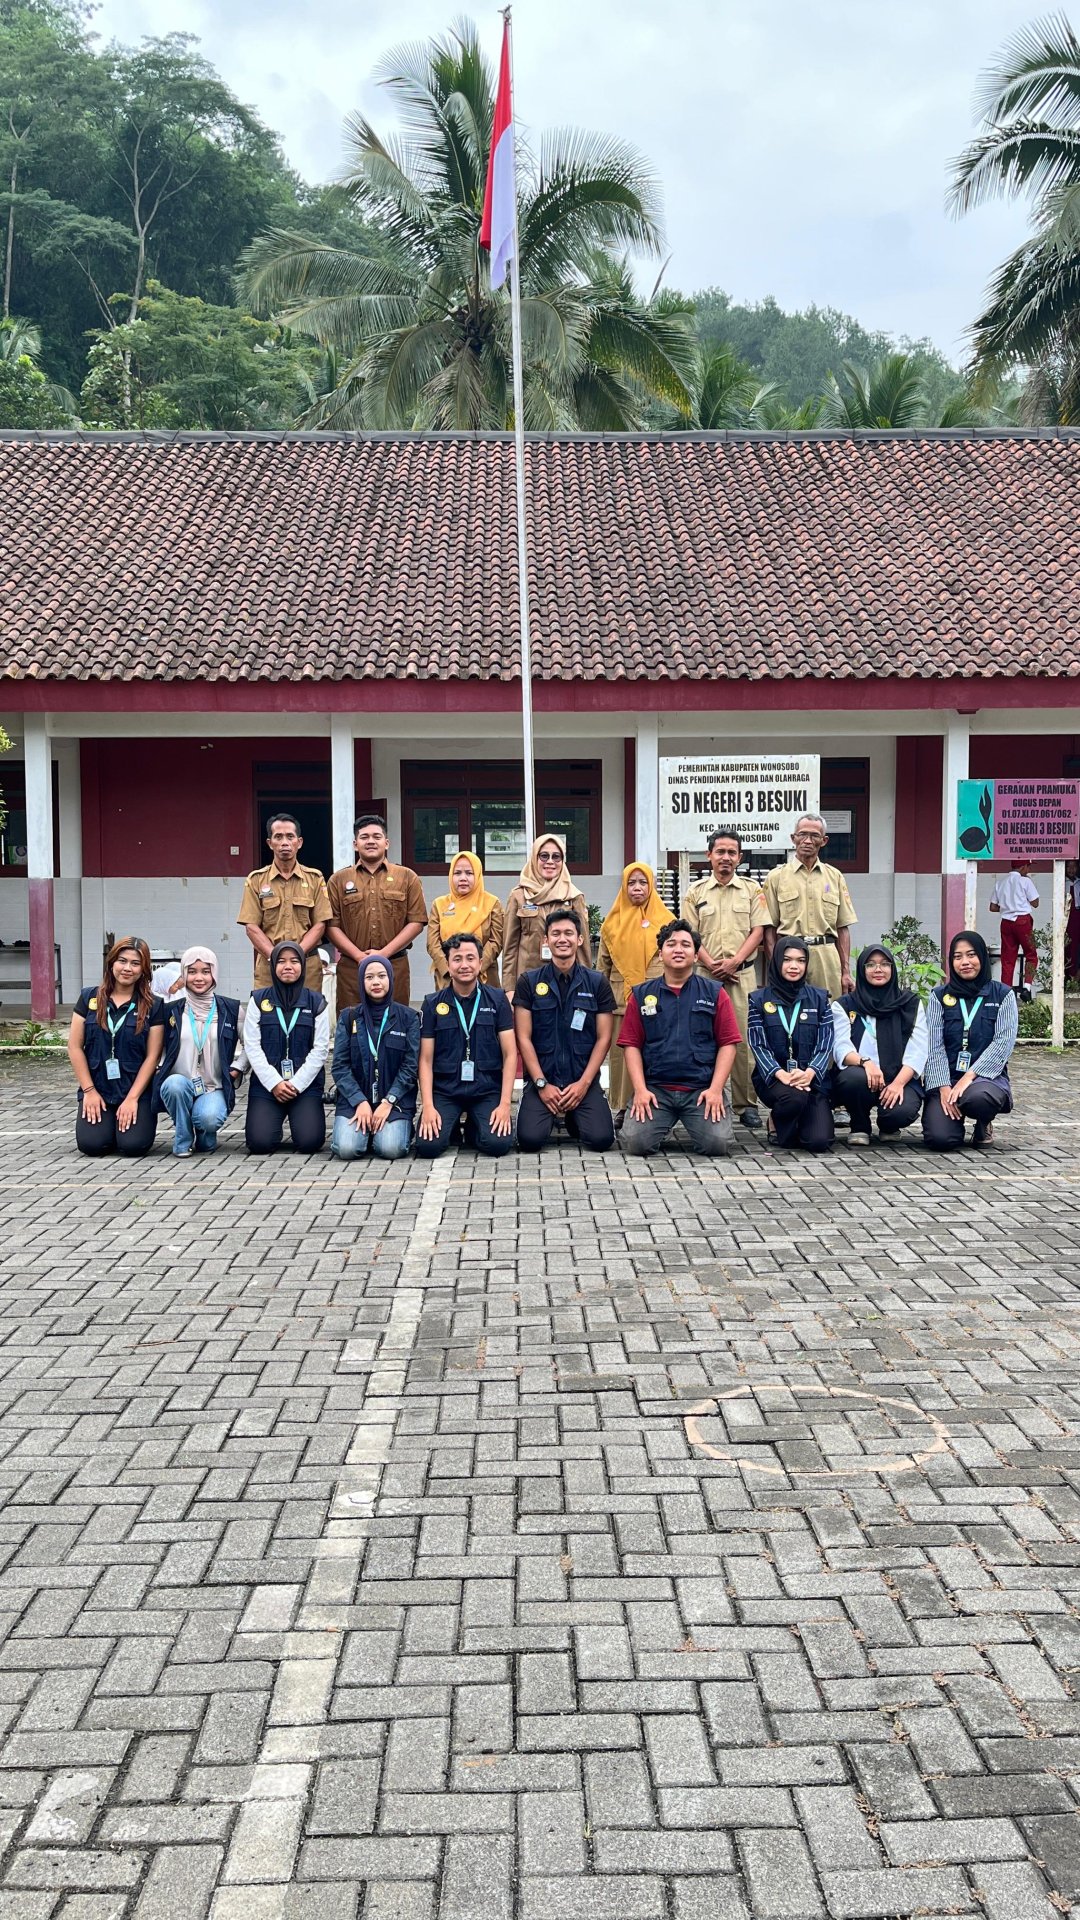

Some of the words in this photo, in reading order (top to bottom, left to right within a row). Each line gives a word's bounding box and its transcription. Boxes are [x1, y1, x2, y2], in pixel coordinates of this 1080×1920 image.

[678, 764, 720, 773] PEMERINTAH
[721, 763, 759, 772] KABUPATEN
[760, 762, 800, 771] WONOSOBO
[668, 775, 689, 785] DINAS
[689, 775, 730, 784] PENDIDIKAN
[731, 774, 759, 783] PEMUDA
[760, 774, 775, 783] DAN
[775, 773, 810, 782] OLAHRAGA
[997, 785, 1035, 795] GERAKAN
[1036, 784, 1077, 794] PRAMUKA
[671, 792, 690, 814] SD
[693, 791, 741, 814] NEGERI
[745, 790, 754, 813] 3
[757, 790, 807, 812] BESUKI
[1012, 799, 1038, 807] GUGUS
[1038, 798, 1062, 807] DEPAN
[997, 822, 1008, 835] SD
[1010, 822, 1038, 835] NEGERI
[1039, 822, 1045, 835] 3
[1046, 822, 1076, 834] BESUKI
[739, 834, 773, 842] NOSOBO
